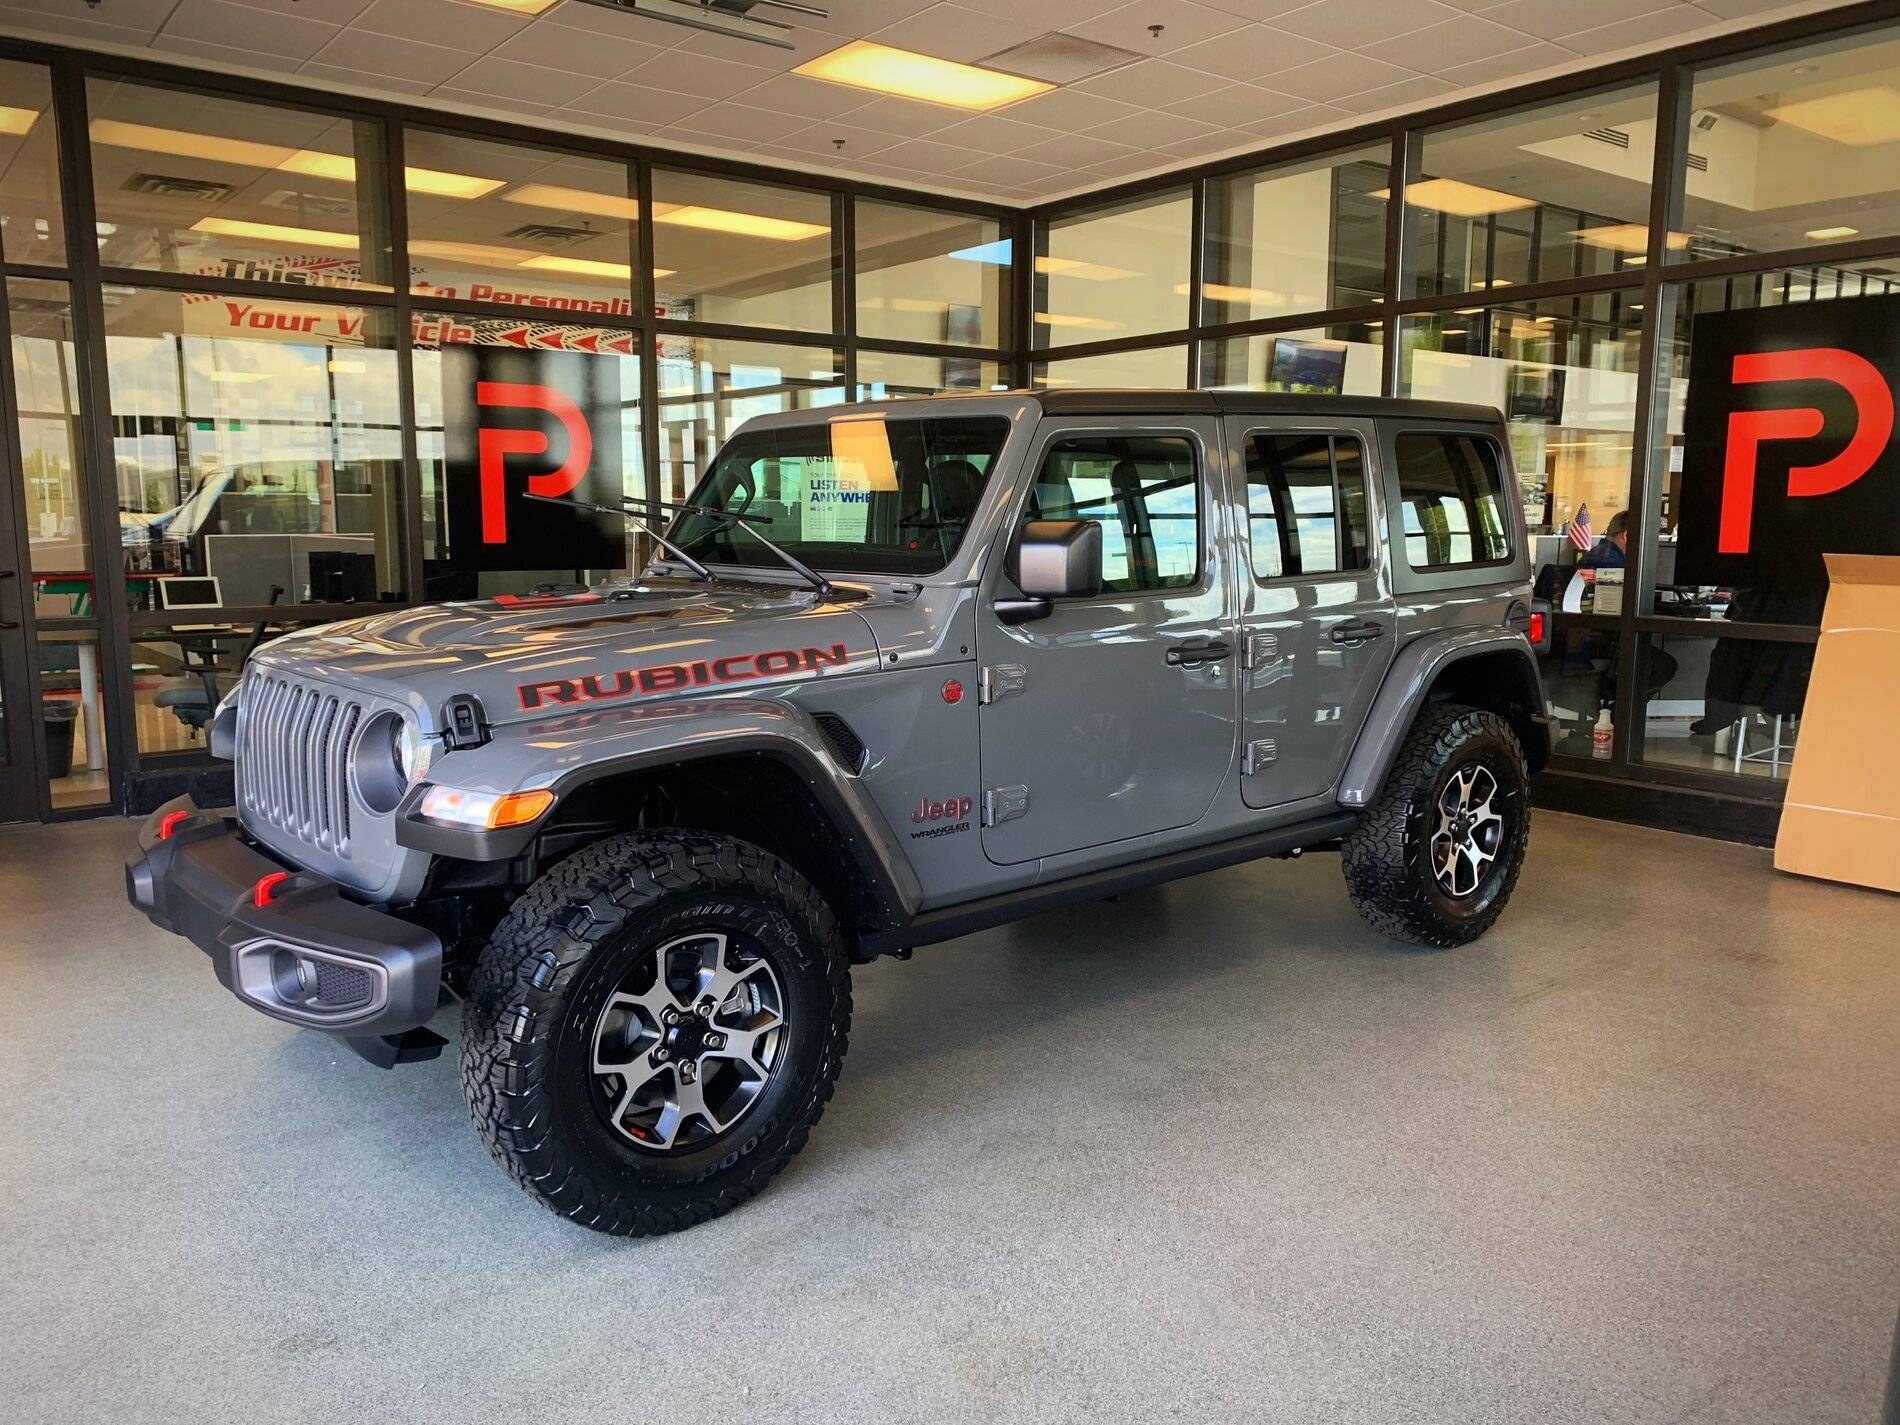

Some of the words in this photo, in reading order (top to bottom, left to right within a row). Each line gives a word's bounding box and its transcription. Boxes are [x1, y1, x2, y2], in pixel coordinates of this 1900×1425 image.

[220, 258, 307, 286] This
[225, 302, 321, 333] Your
[337, 312, 474, 343] Vicle
[477, 381, 591, 544] P
[1719, 348, 1895, 554] P
[810, 479, 858, 490] LISTEN
[517, 642, 848, 711] RUBICON
[910, 796, 973, 823] Jeep
[910, 822, 970, 839] WRANGLER
